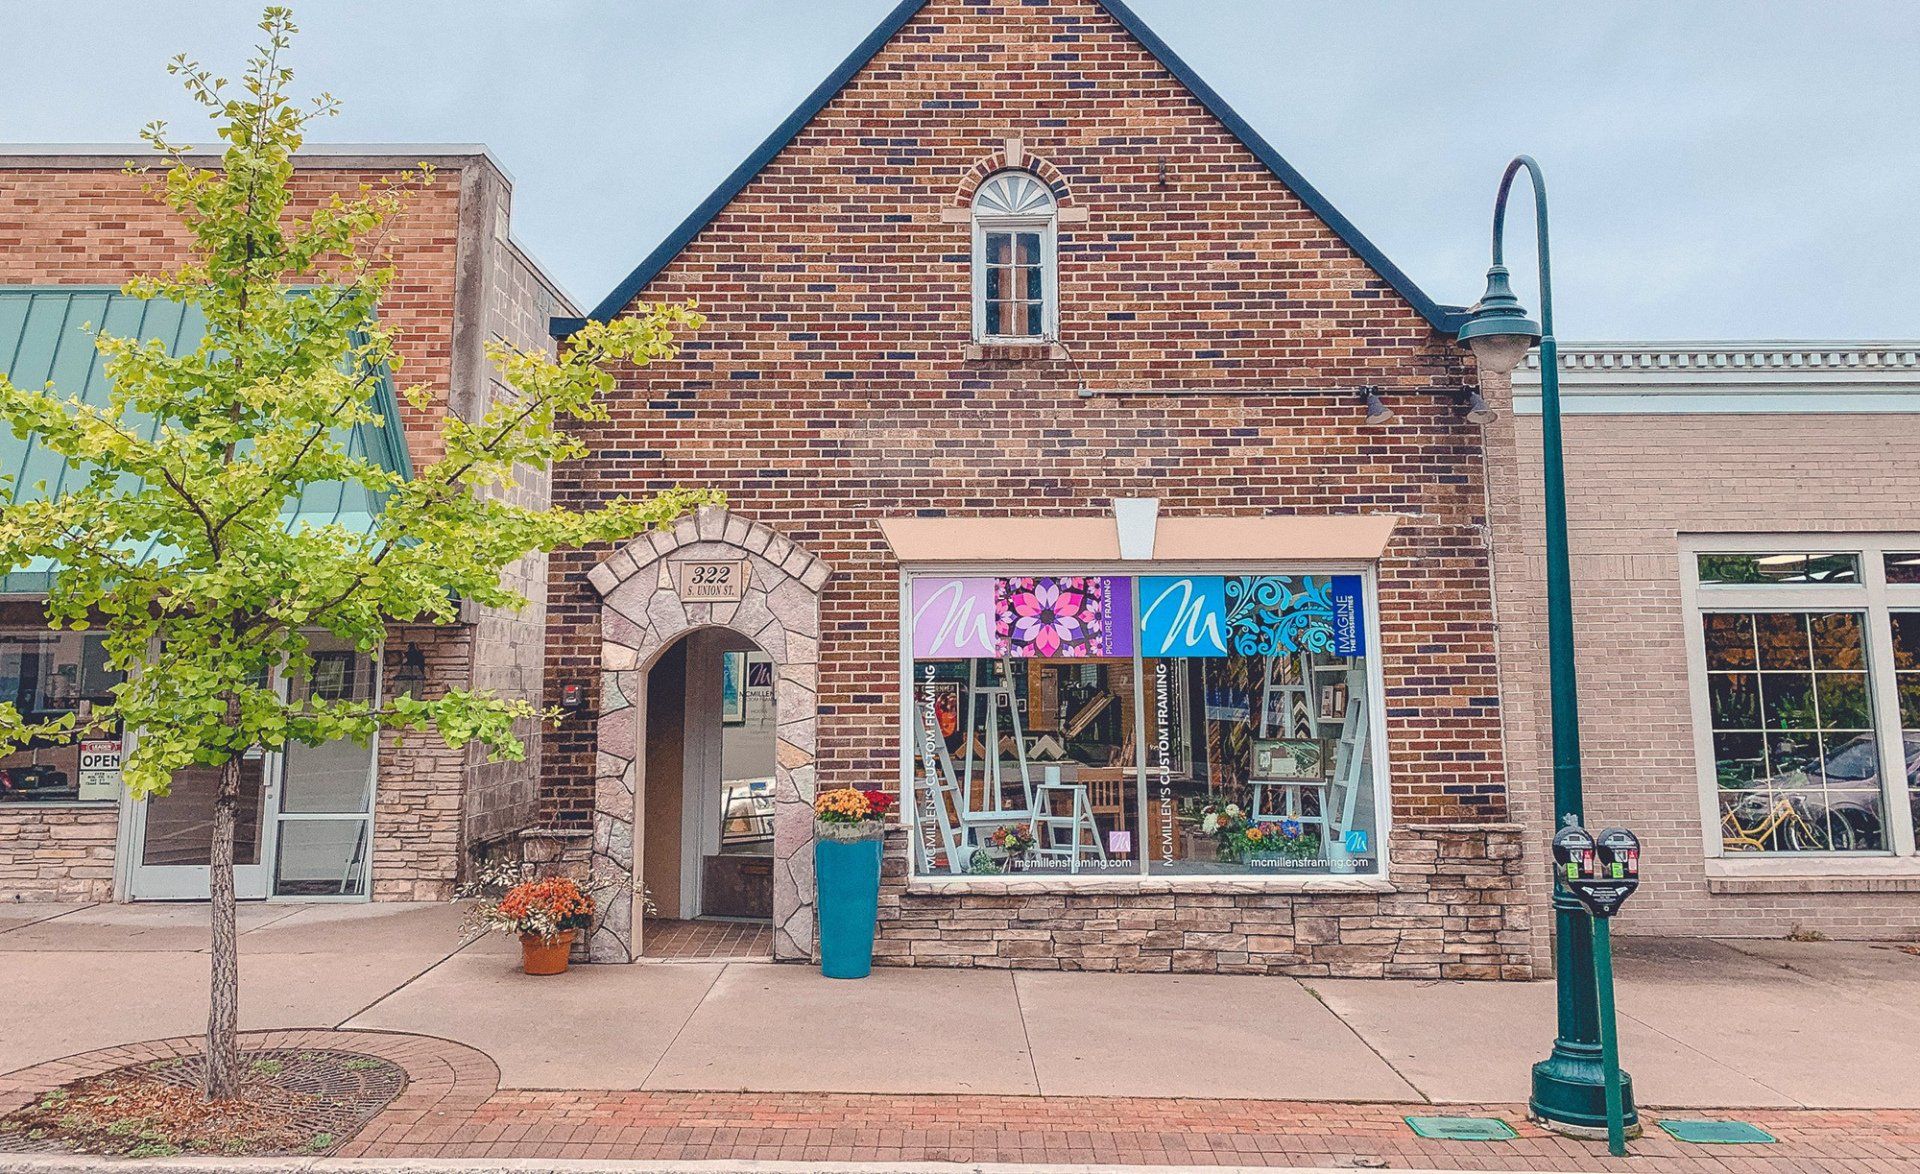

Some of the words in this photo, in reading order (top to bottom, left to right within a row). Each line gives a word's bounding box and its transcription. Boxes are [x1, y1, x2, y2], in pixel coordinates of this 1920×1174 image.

[687, 586, 694, 595] S.
[698, 586, 721, 595] UNION
[724, 586, 734, 595] ST.
[692, 566, 730, 584] 322
[1336, 595, 1350, 653] IMAGINE
[925, 665, 936, 726] FRAMING
[1156, 663, 1168, 725] FRAMING
[83, 755, 120, 767] OPEN
[926, 731, 936, 786] CUSTOM
[1158, 728, 1170, 785] CUSTOM
[926, 788, 936, 869] MCMILLEN'S
[1160, 787, 1173, 867] MCMILLEN'S
[1251, 857, 1369, 868] mcmillensframing.com
